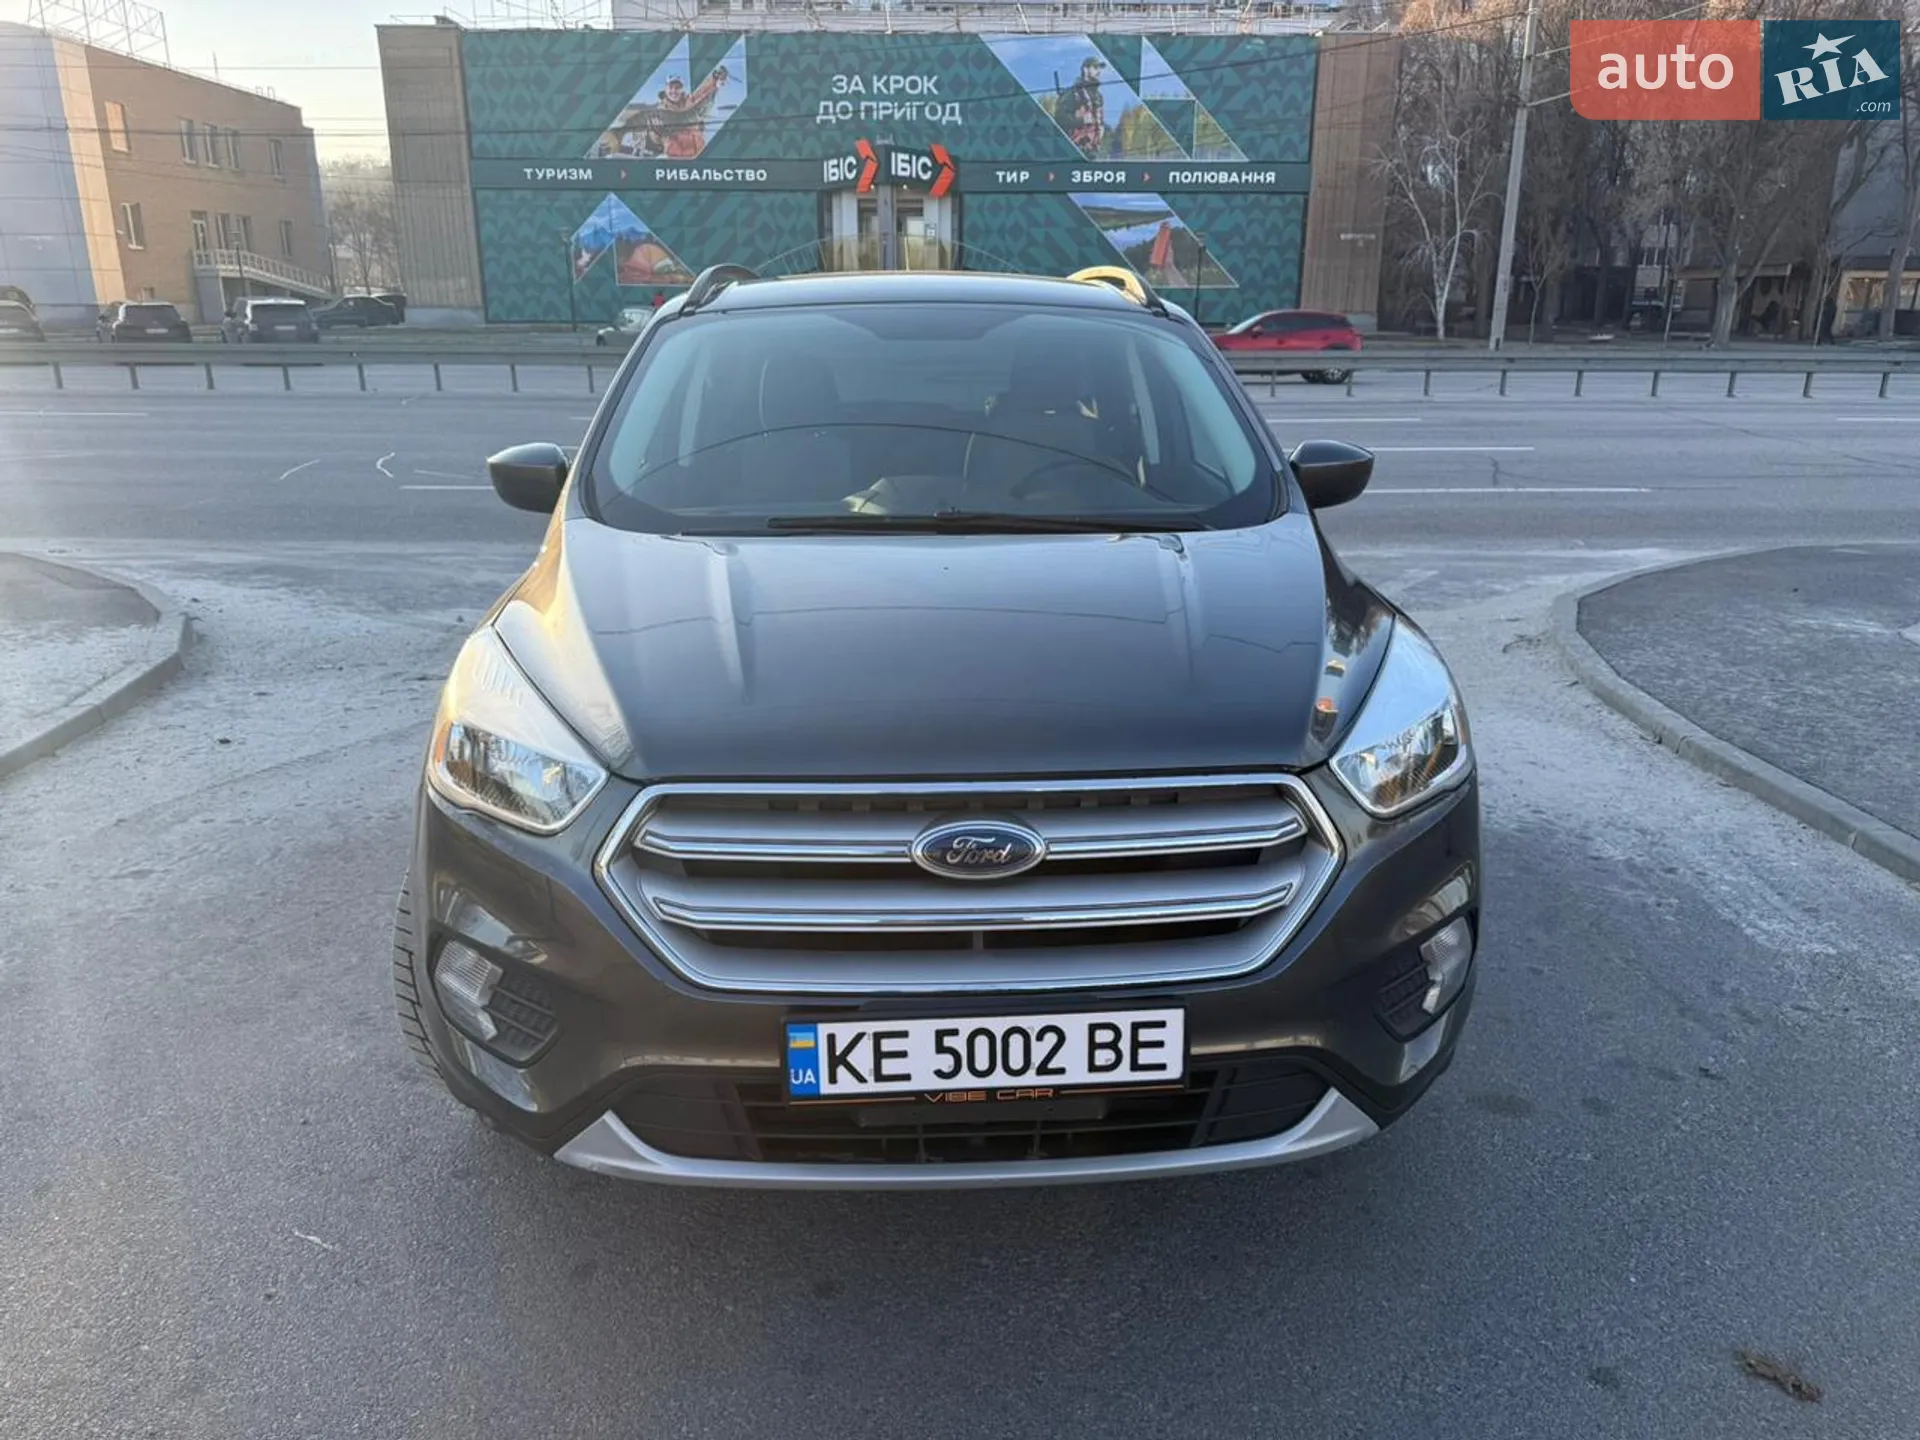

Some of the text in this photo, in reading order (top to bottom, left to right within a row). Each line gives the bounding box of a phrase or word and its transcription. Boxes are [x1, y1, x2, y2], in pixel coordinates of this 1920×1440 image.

[832, 74, 940, 96] ЗА КРОК
[816, 100, 963, 126] ДО ПРИГОД
[523, 167, 768, 182] ТУРИЗМ РИБАЛЬСТВО
[823, 156, 858, 183] ІБІС
[890, 151, 933, 180] ІБІС
[995, 170, 1277, 184] ТИР ЗБРОЯ ПОЛЮВАННЯ
[946, 835, 1013, 864] Ford
[826, 1019, 1168, 1085] KE 5002 BE
[790, 1068, 817, 1085] UA
[924, 1088, 1054, 1104] VIBE CAR
